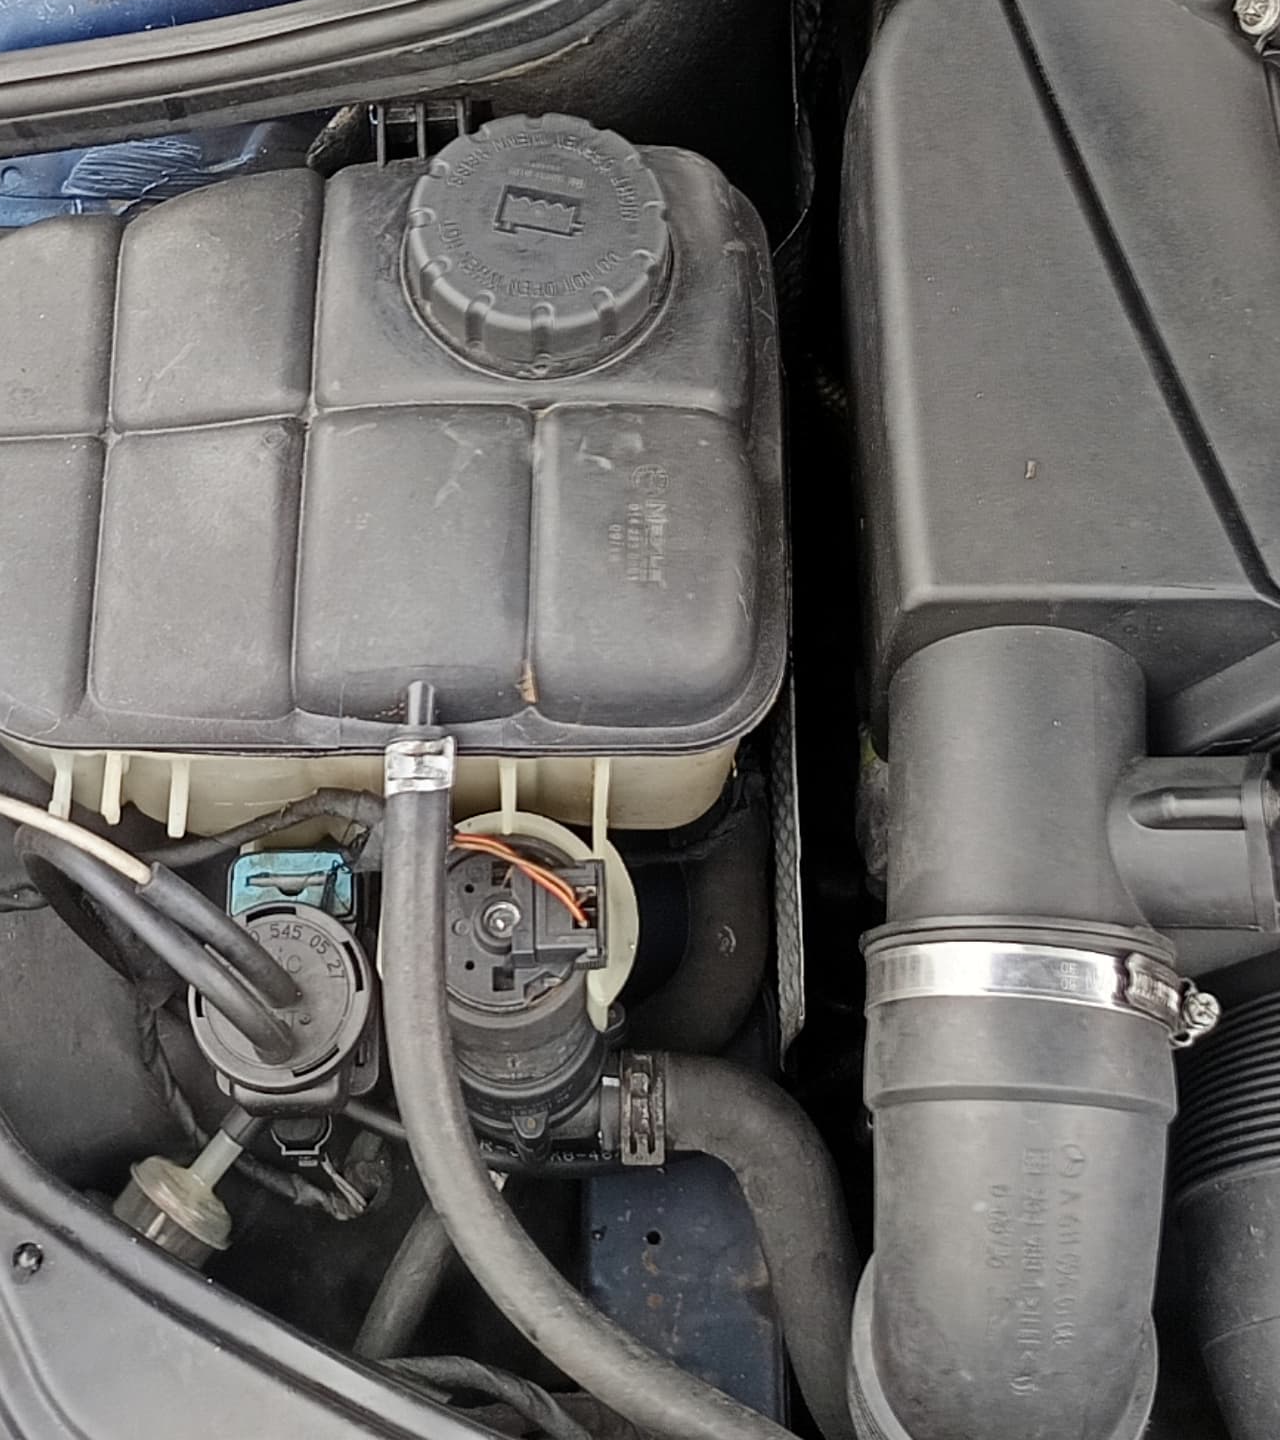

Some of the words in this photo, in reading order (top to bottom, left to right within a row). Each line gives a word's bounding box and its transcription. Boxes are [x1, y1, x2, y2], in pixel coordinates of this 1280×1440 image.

[269, 922, 303, 940] 545
[309, 933, 331, 955] 05
[325, 959, 345, 978] 27
